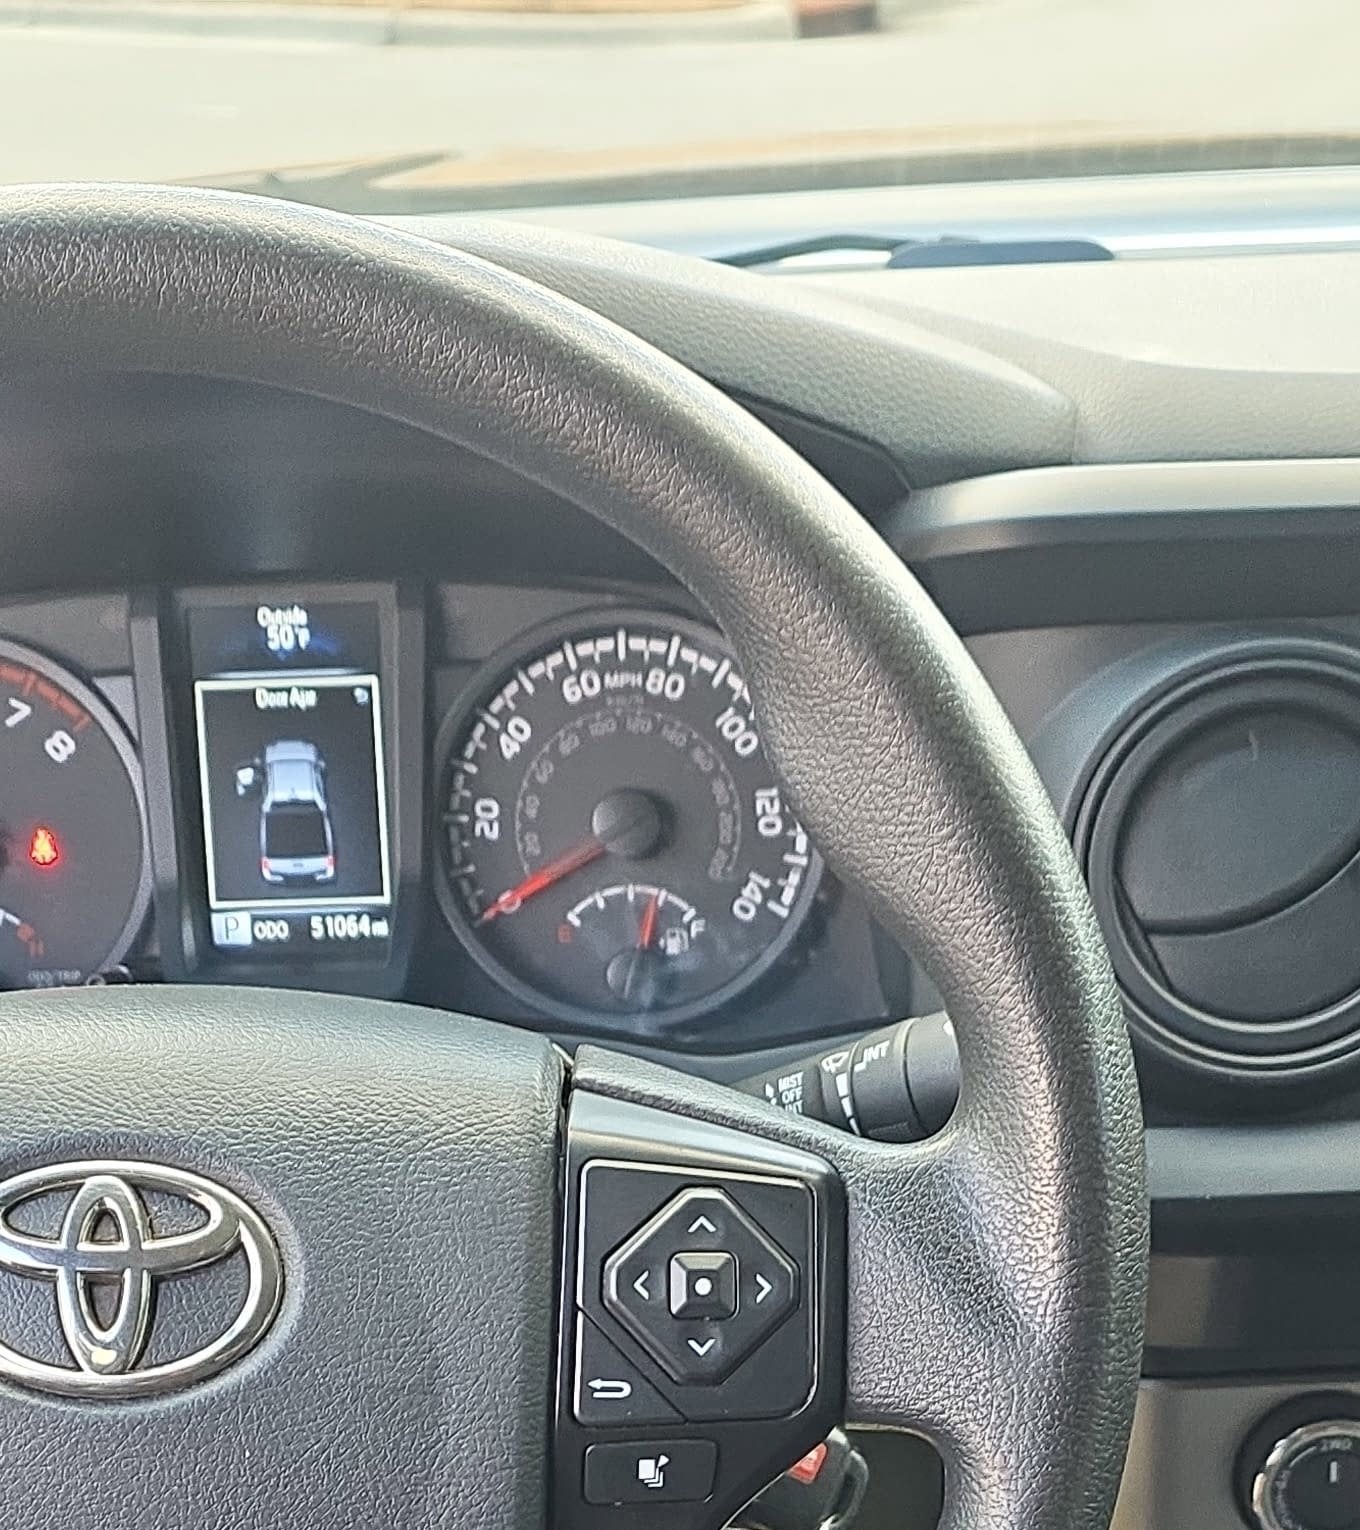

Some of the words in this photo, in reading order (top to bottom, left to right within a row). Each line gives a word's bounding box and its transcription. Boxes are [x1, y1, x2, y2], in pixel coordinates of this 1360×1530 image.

[562, 671, 601, 703] 60
[603, 672, 643, 690] MPH
[644, 671, 686, 701] 80
[5, 697, 31, 727] 7
[45, 730, 76, 762] 8
[498, 716, 532, 761] 40
[715, 706, 758, 757] 100
[474, 798, 500, 840] 20
[755, 787, 783, 838] 120
[732, 870, 772, 922] 140
[224, 917, 240, 941] P
[254, 920, 289, 940] ODO
[782, 1086, 802, 1104] OFF
